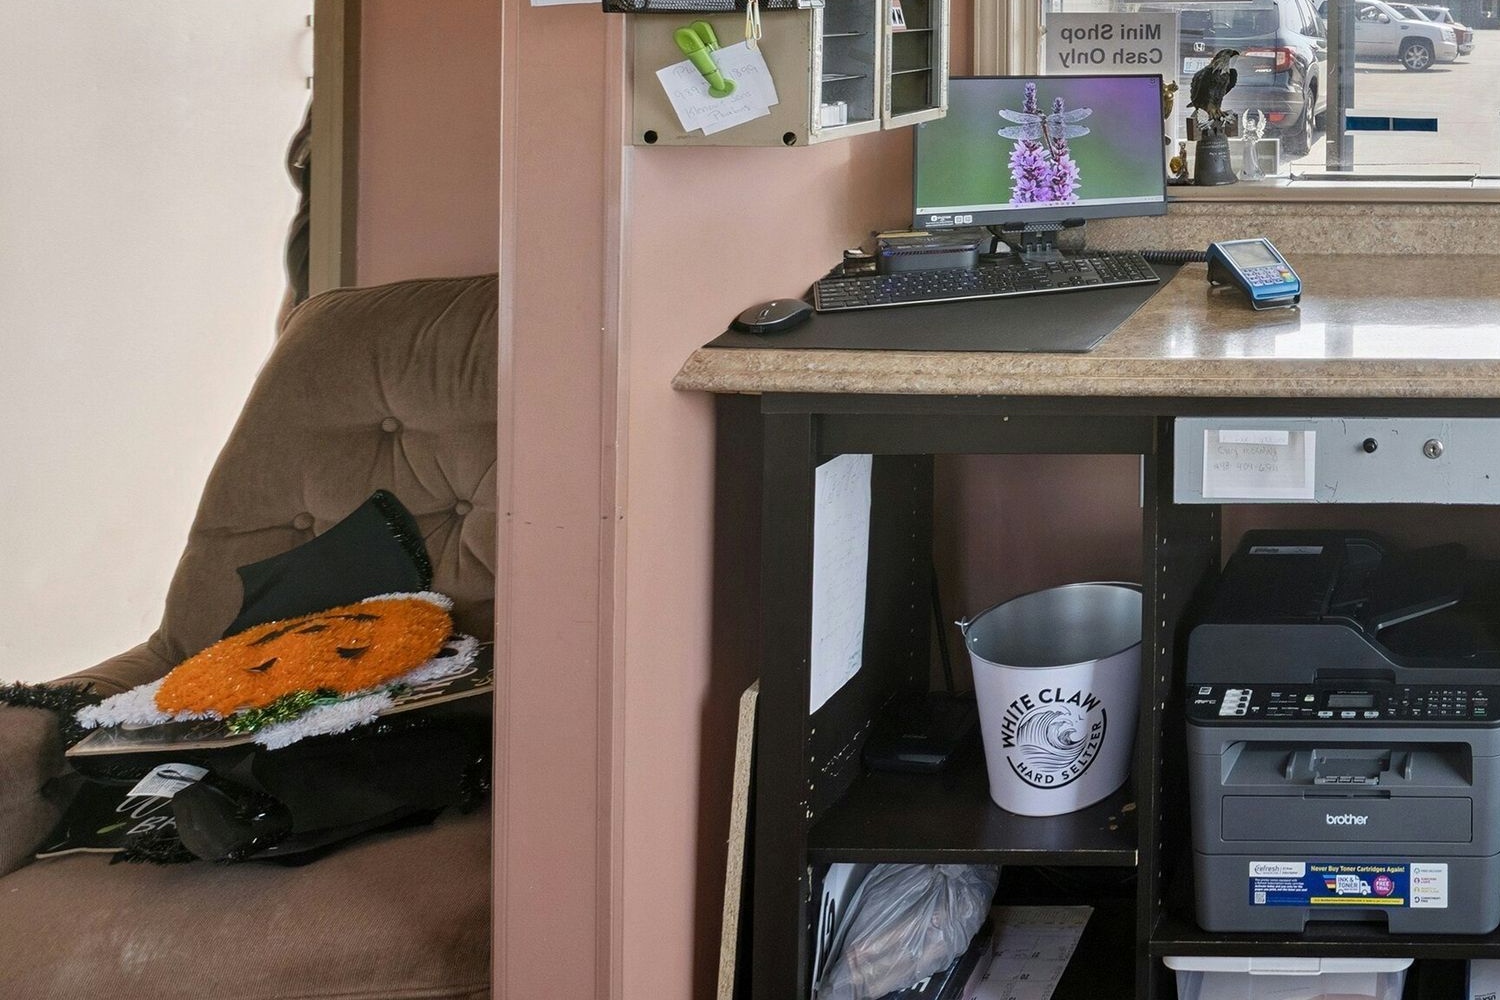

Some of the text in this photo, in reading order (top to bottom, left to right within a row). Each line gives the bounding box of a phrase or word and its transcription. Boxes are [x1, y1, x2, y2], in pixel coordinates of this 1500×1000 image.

[1002, 687, 1103, 749] WHITE CLAW
[1016, 720, 1102, 784] HARD SELTZER
[1326, 813, 1368, 827] brother
[1328, 865, 1339, 873] Buy
